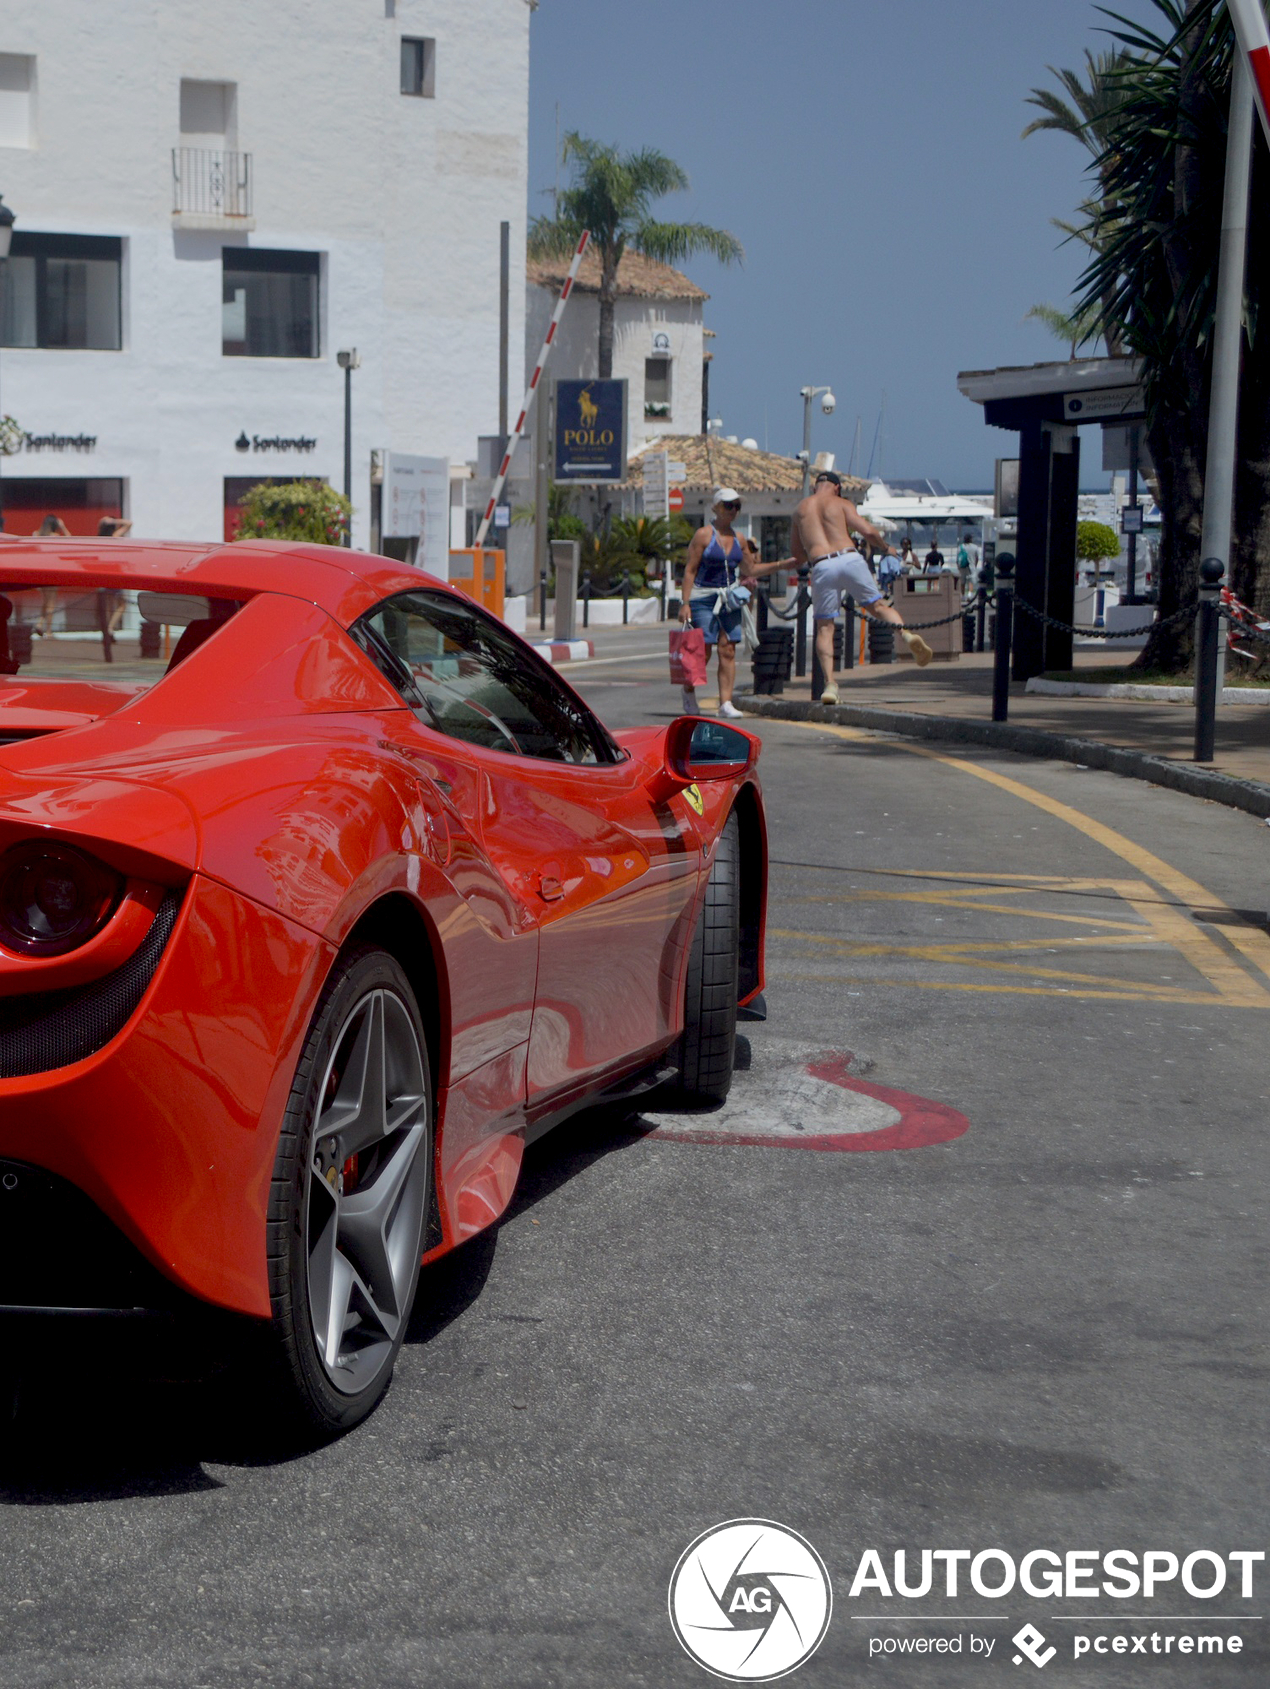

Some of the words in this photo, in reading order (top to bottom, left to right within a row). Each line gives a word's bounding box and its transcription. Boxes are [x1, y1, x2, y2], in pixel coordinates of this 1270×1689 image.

[26, 433, 97, 447] Santander
[253, 435, 317, 449] Santander
[564, 430, 614, 446] POLO
